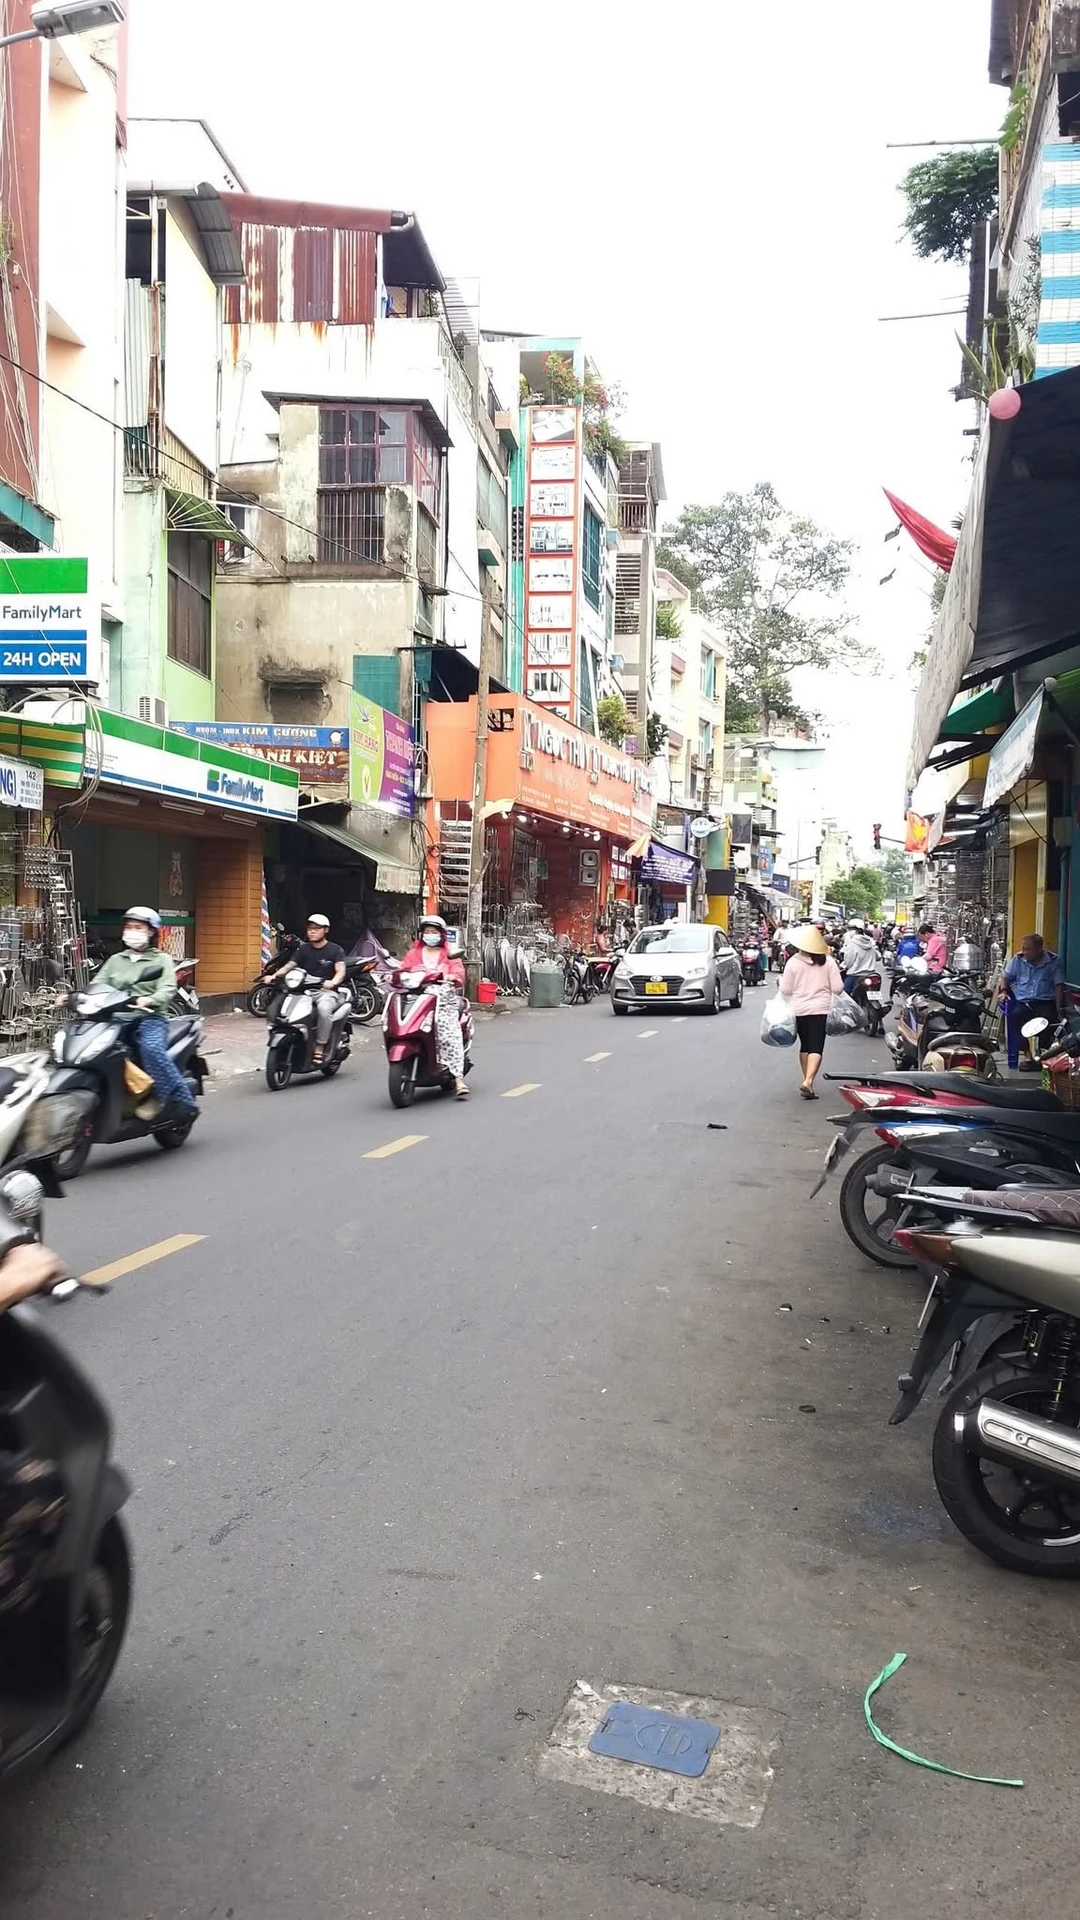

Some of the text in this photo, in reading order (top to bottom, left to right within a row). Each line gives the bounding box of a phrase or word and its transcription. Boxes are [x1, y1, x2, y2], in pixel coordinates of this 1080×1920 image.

[2, 605, 82, 622] FamilyMart
[3, 651, 82, 667] 24H OPEN
[242, 727, 268, 736] KIM
[273, 728, 317, 738] CƯƠNG
[295, 748, 338, 766] KIỆT
[25, 770, 37, 781] 142
[221, 773, 264, 803] FamilyMart
